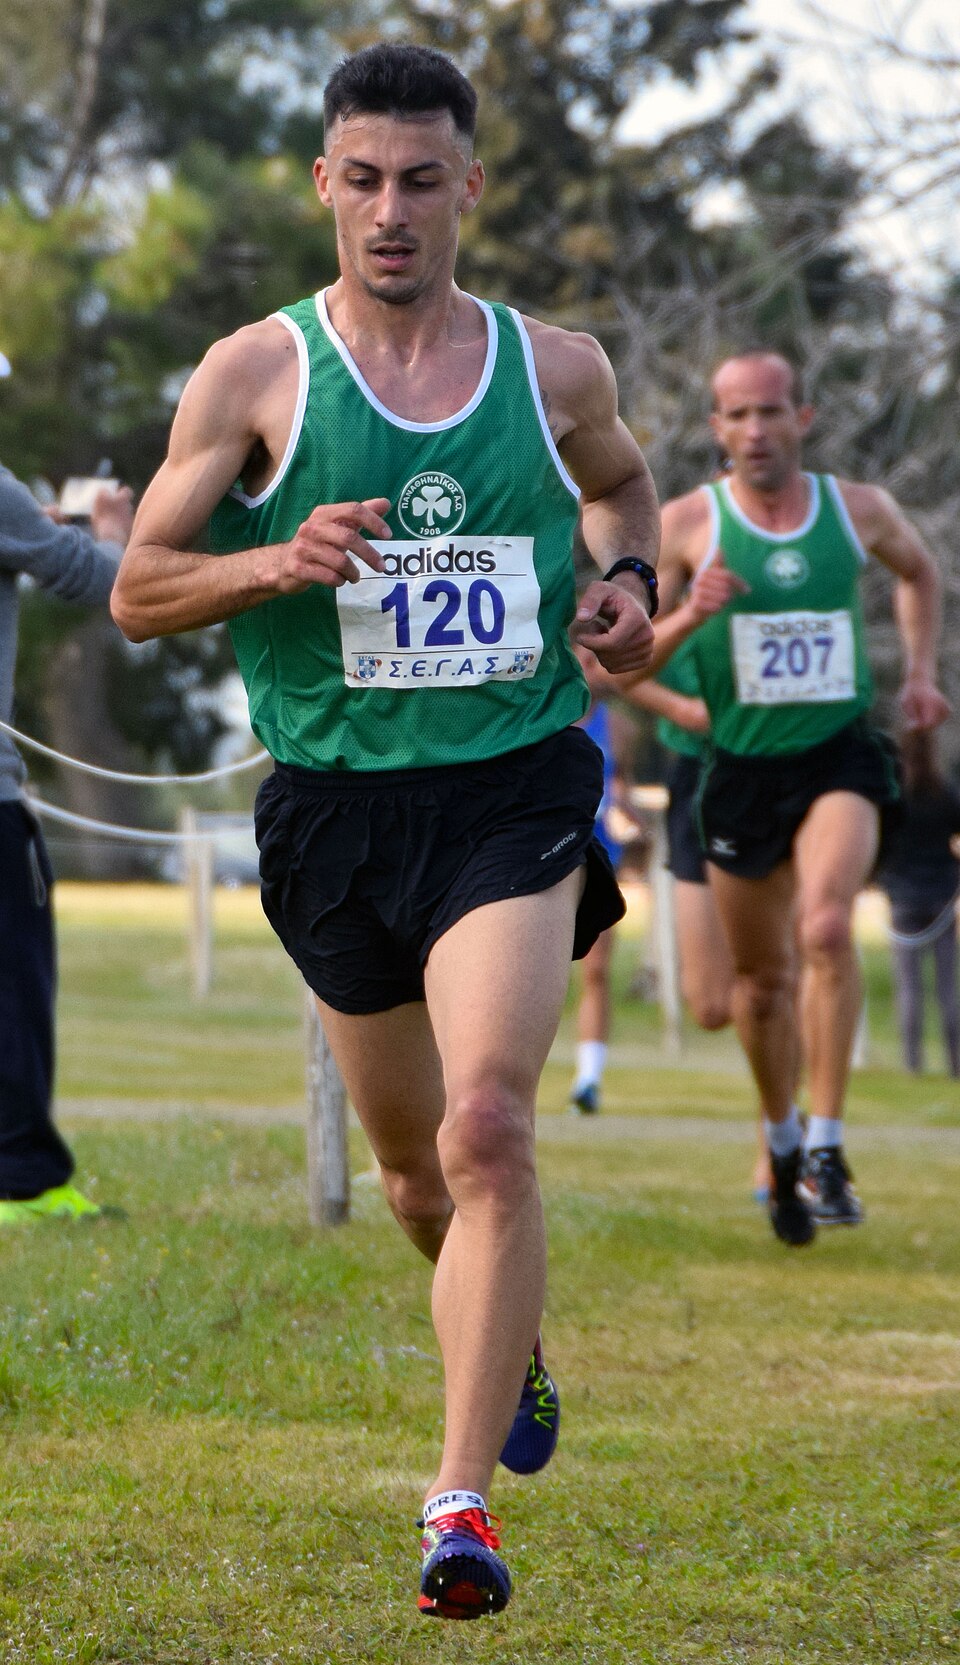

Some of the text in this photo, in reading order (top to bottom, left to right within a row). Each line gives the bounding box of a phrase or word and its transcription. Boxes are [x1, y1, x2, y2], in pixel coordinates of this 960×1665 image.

[420, 527, 441, 536] 1908
[383, 543, 497, 577] adidas
[381, 578, 506, 648] 120
[760, 636, 835, 680] 207
